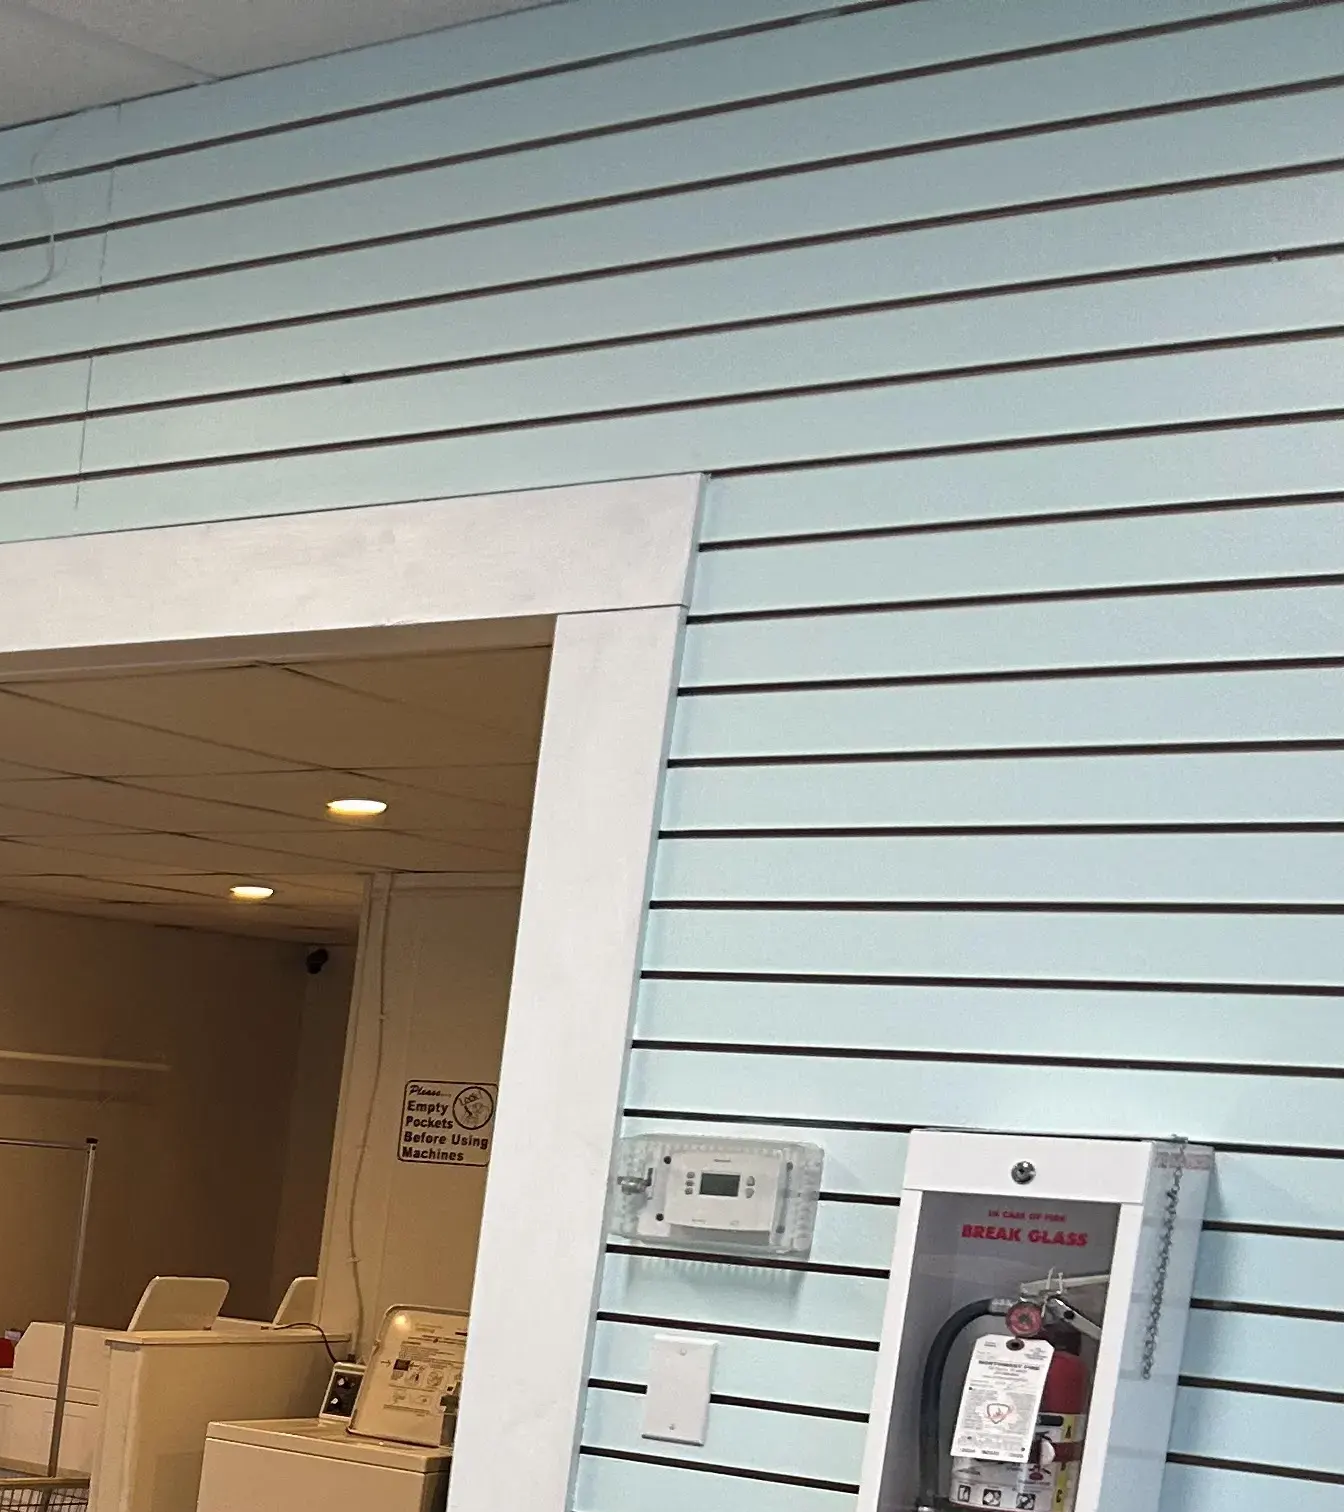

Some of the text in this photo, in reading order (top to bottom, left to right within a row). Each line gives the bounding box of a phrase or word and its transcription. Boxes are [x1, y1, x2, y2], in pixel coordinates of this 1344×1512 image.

[407, 1100, 448, 1116] Empty
[405, 1115, 453, 1129] Pockets
[403, 1131, 489, 1150] Before Using
[401, 1146, 464, 1161] Machines
[961, 1223, 1088, 1247] BREAK GLASS
